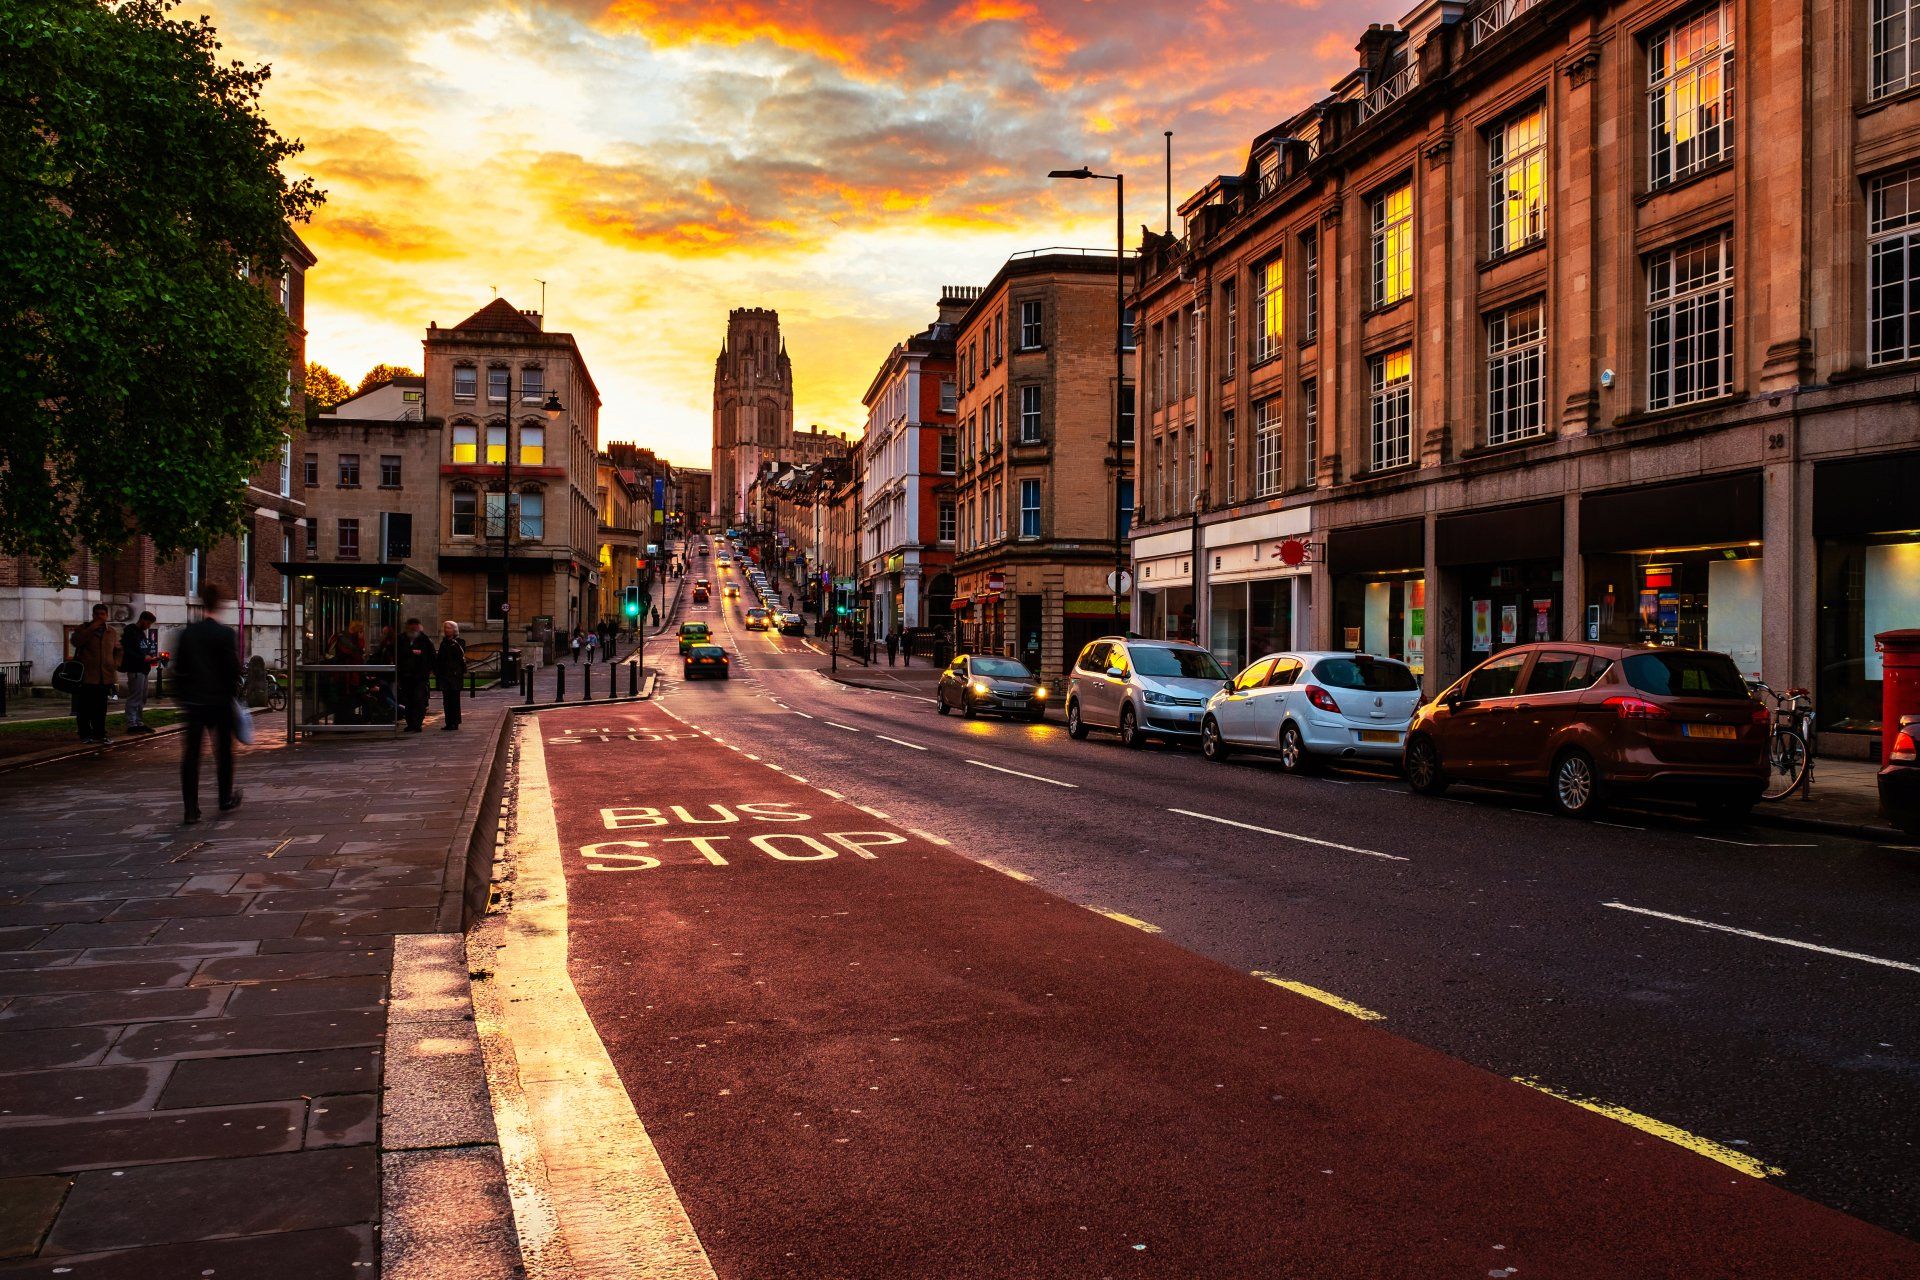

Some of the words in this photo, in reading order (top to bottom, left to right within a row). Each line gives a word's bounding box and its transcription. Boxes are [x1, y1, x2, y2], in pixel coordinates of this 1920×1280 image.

[548, 733, 700, 745] STOP
[600, 803, 812, 829] BUS
[579, 831, 907, 871] STOP
